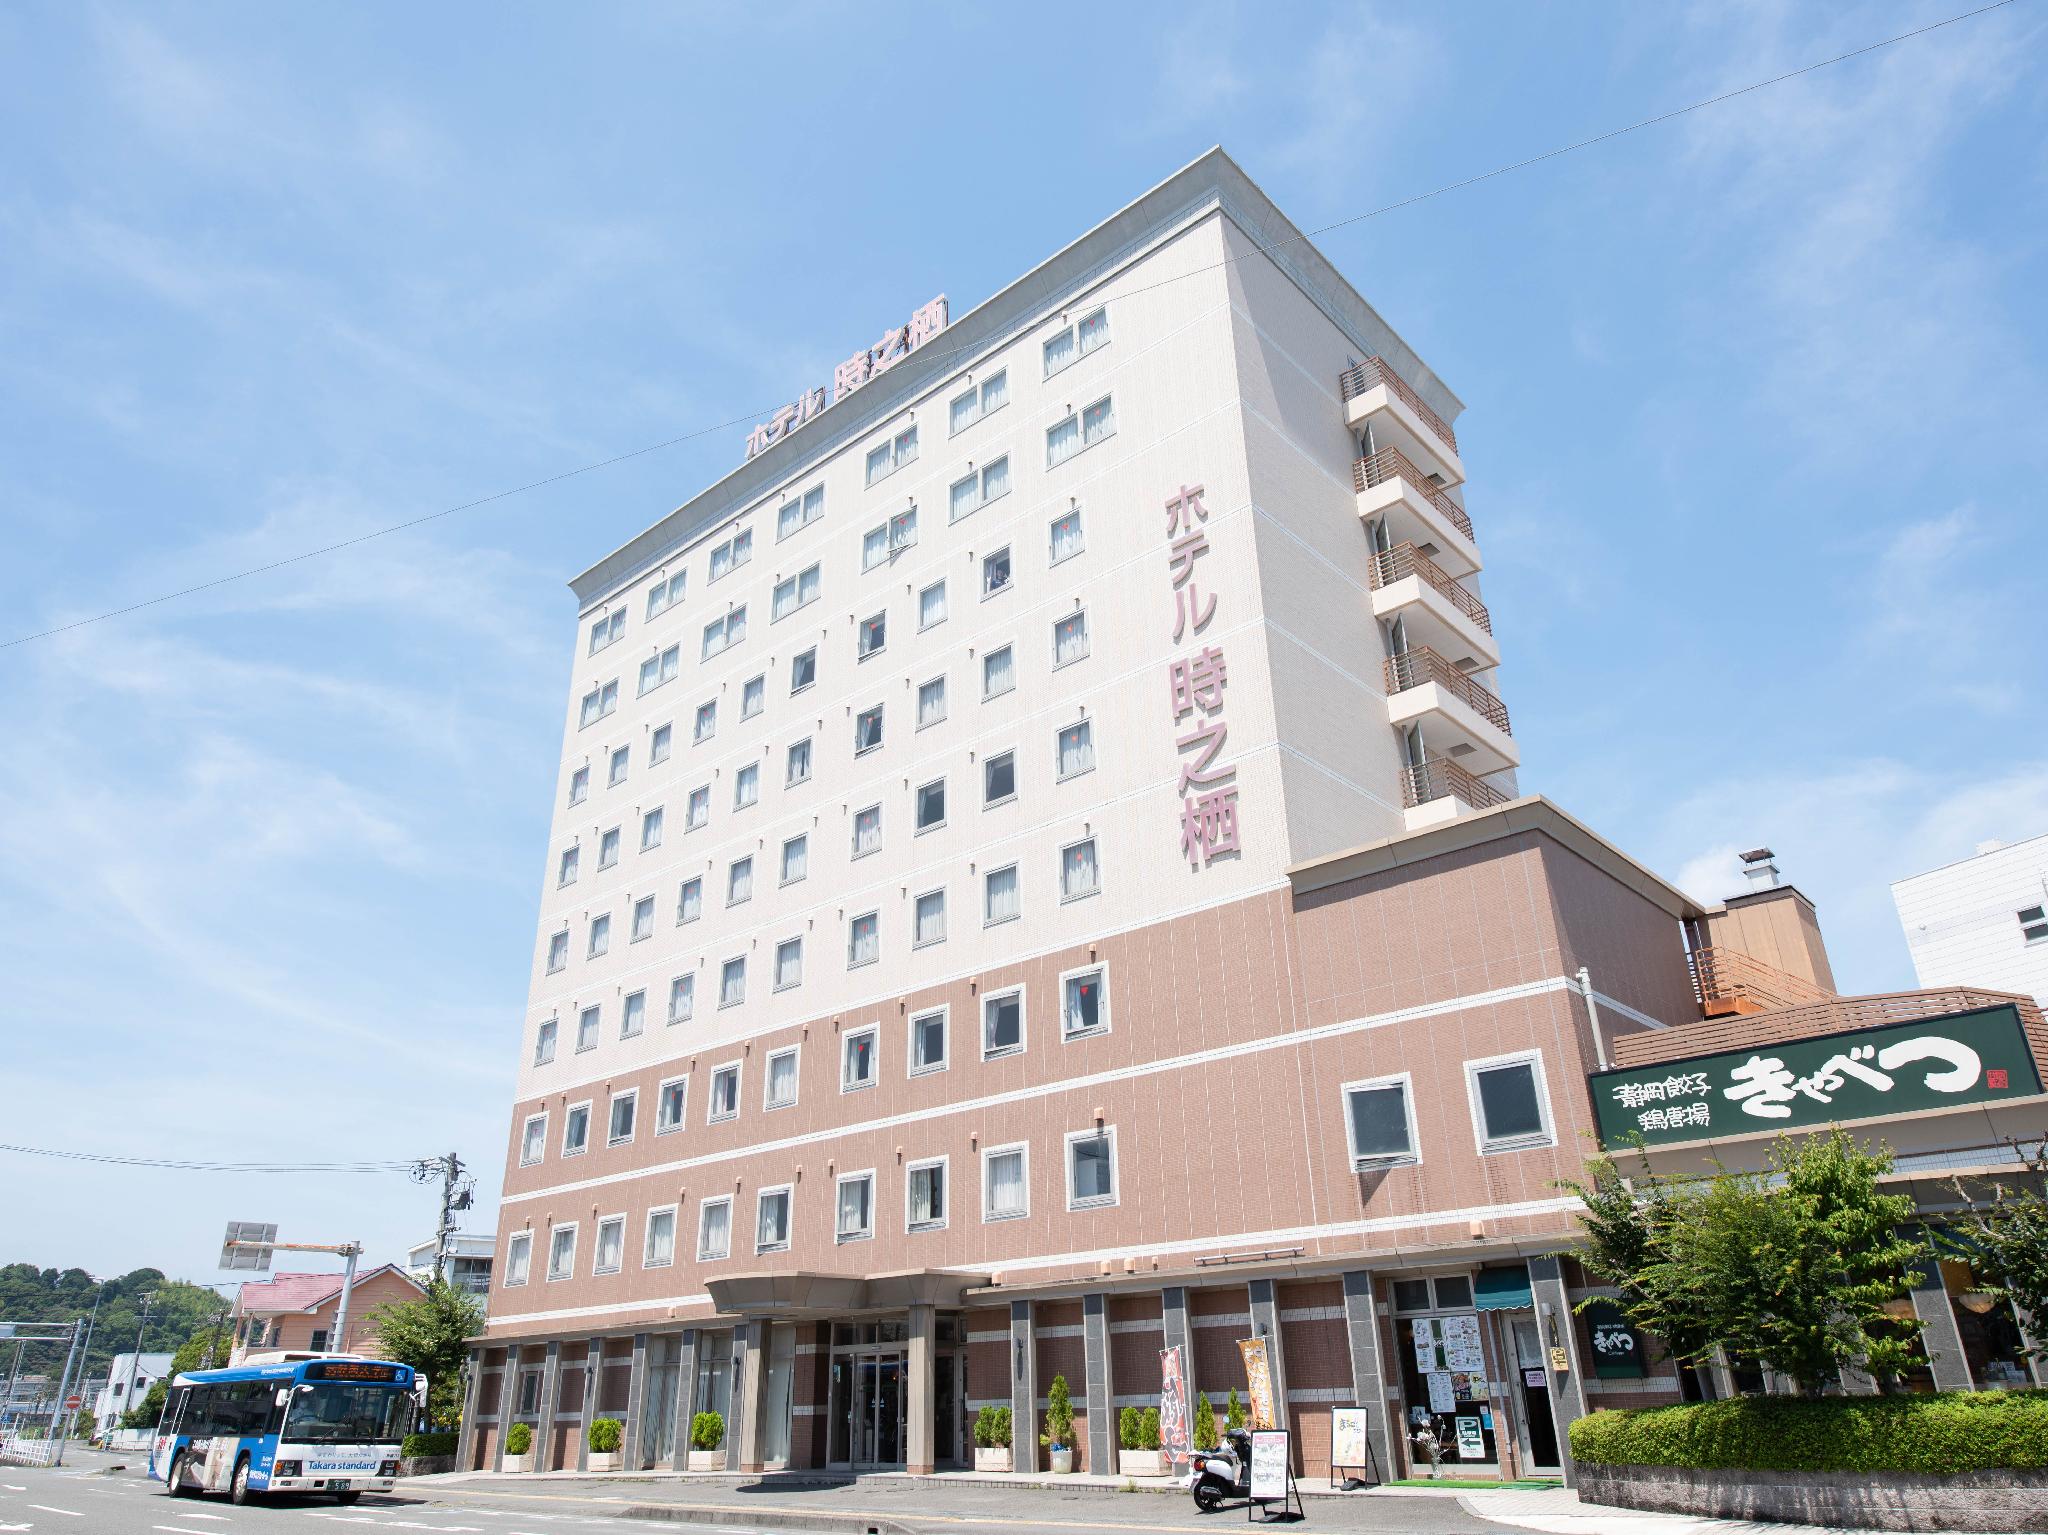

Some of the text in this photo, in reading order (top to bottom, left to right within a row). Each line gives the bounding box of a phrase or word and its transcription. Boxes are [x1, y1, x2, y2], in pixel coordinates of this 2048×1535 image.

[746, 293, 948, 460] ホテル 時之栖
[1165, 484, 1242, 873] ホテル 時之栖
[1612, 1072, 1712, 1109] 静岡餃子
[1723, 1036, 1982, 1119] きゃべつ
[1637, 1102, 1711, 1132] 鶏唐揚
[1594, 1330, 1634, 1353] きゃべつ
[1459, 1420, 1477, 1430] P
[308, 1460, 376, 1470] Takara standard
